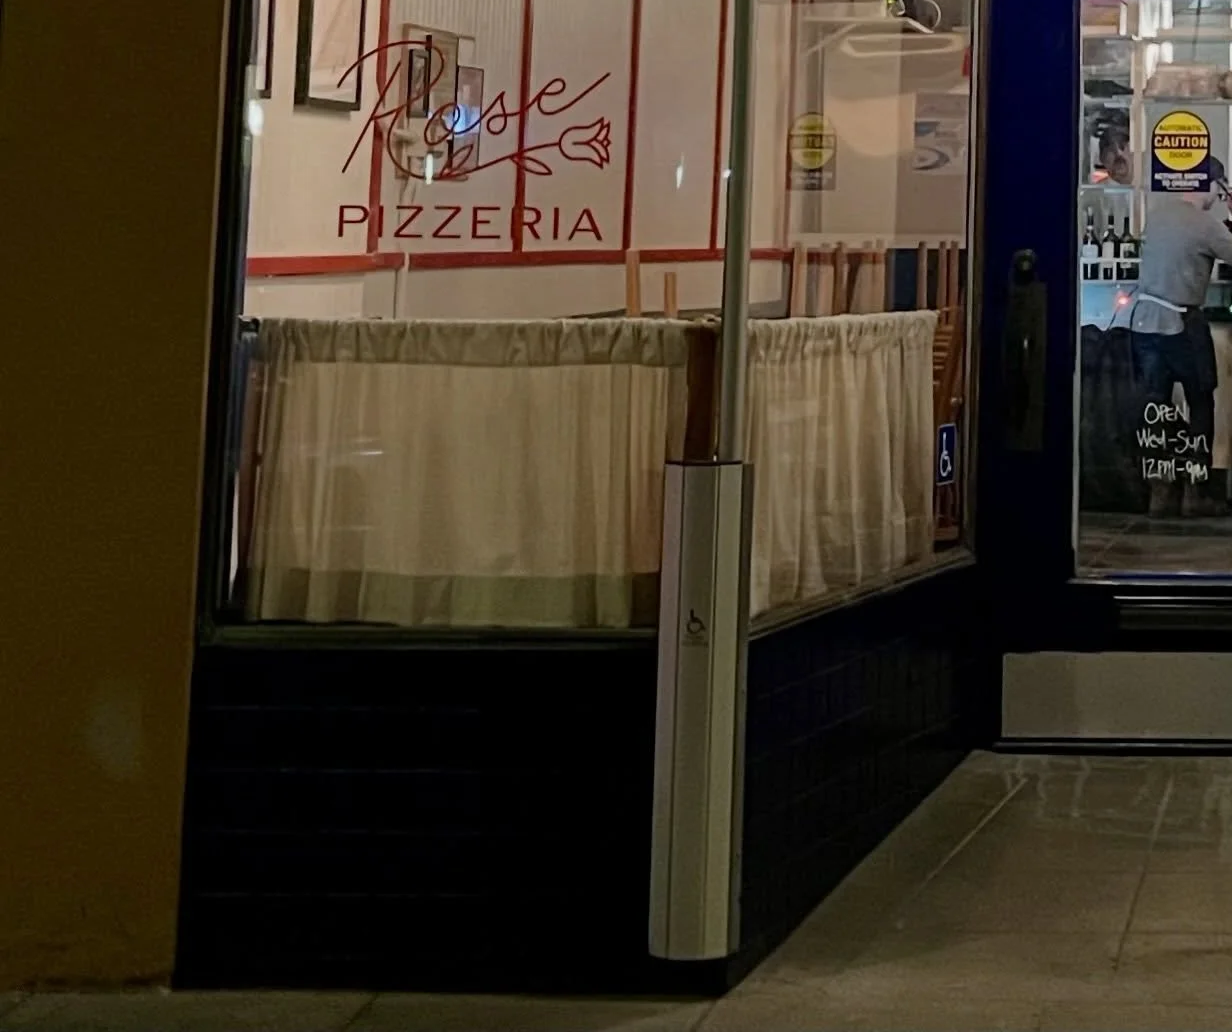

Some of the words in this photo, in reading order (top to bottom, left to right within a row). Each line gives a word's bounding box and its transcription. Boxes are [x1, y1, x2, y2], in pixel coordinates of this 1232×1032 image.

[337, 40, 611, 180] Rose
[1154, 135, 1208, 148] CAUTION
[337, 204, 603, 241] PIZZERIA
[1144, 402, 1190, 424] OPEN
